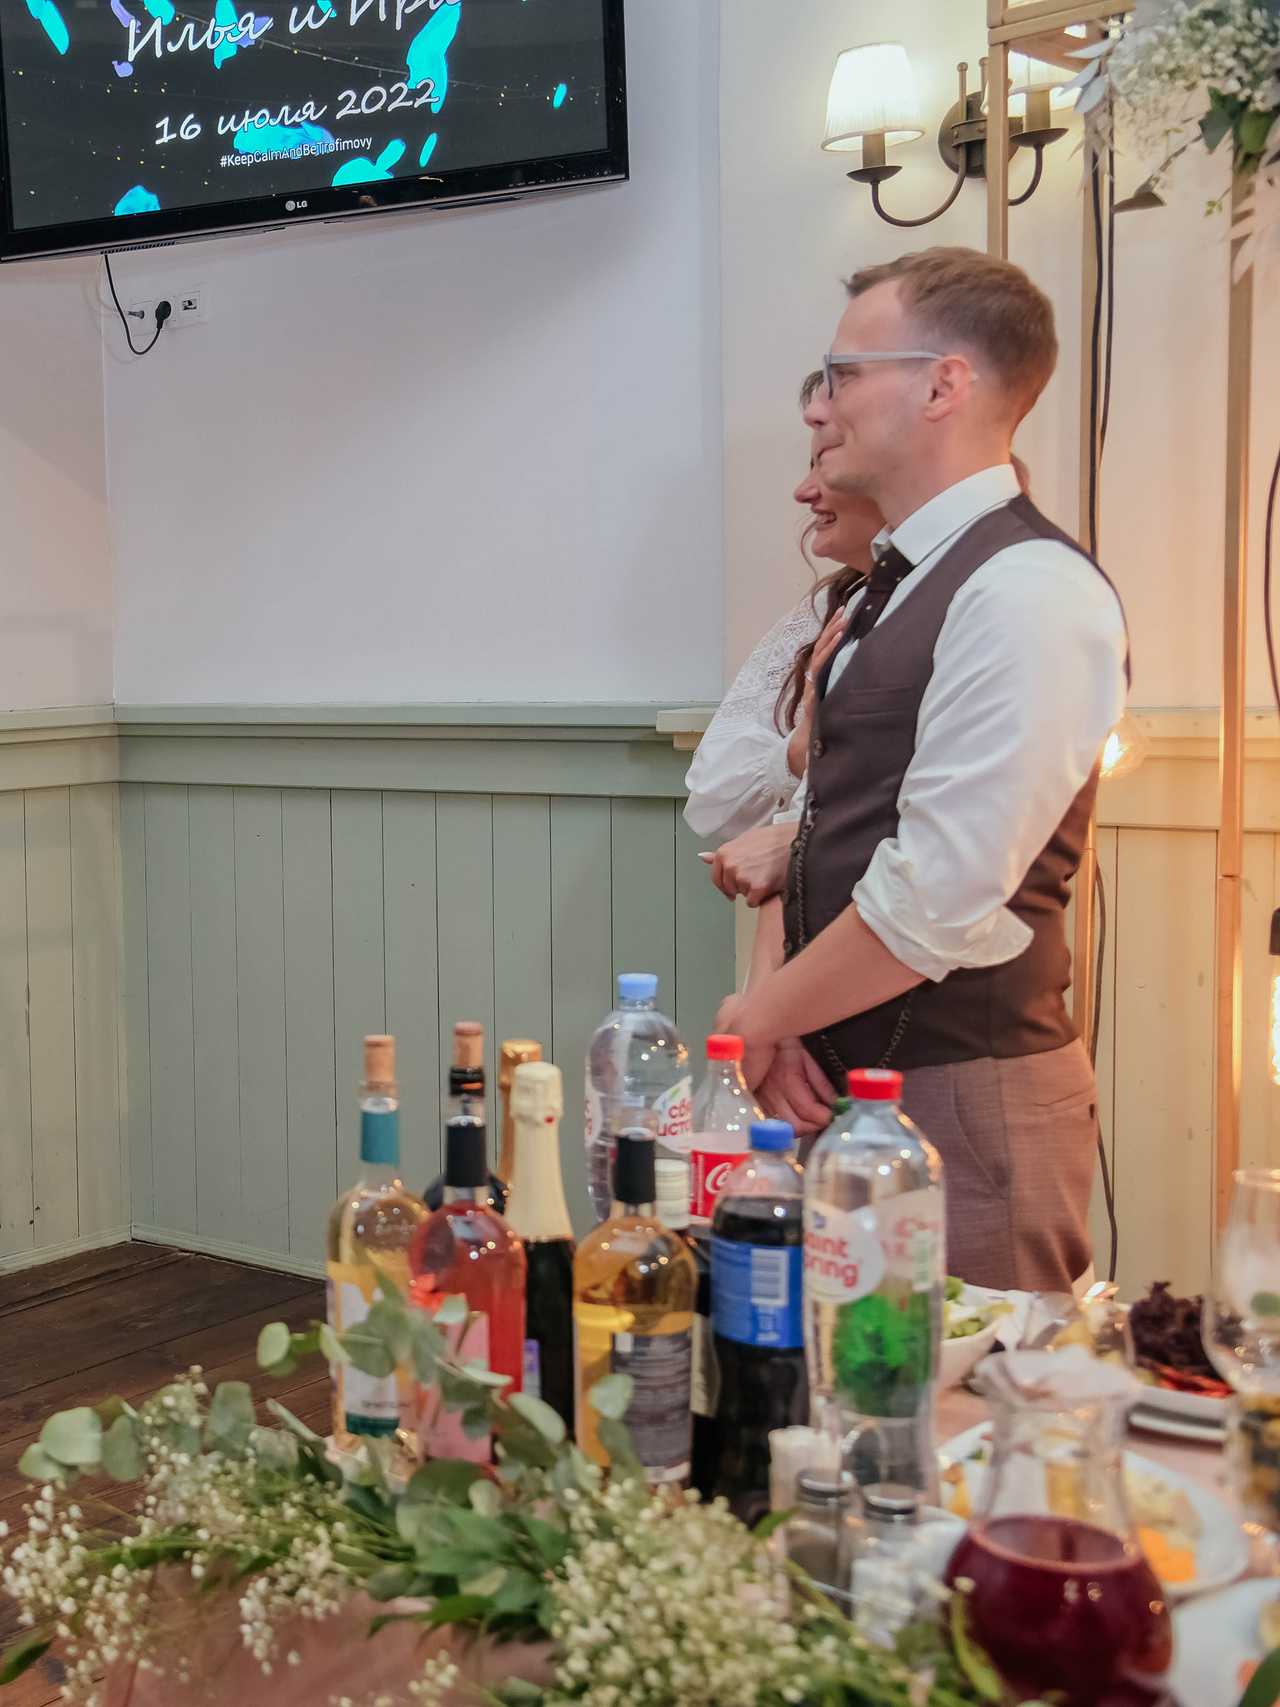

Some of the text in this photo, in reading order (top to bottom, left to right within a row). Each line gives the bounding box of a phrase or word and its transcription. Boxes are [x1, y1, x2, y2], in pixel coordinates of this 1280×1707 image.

[127, 12, 274, 61] Илья
[289, 5, 333, 34] и
[155, 78, 440, 145] 16 июля 2022
[220, 136, 373, 168] #KeepCalmAndBeTrofimovy
